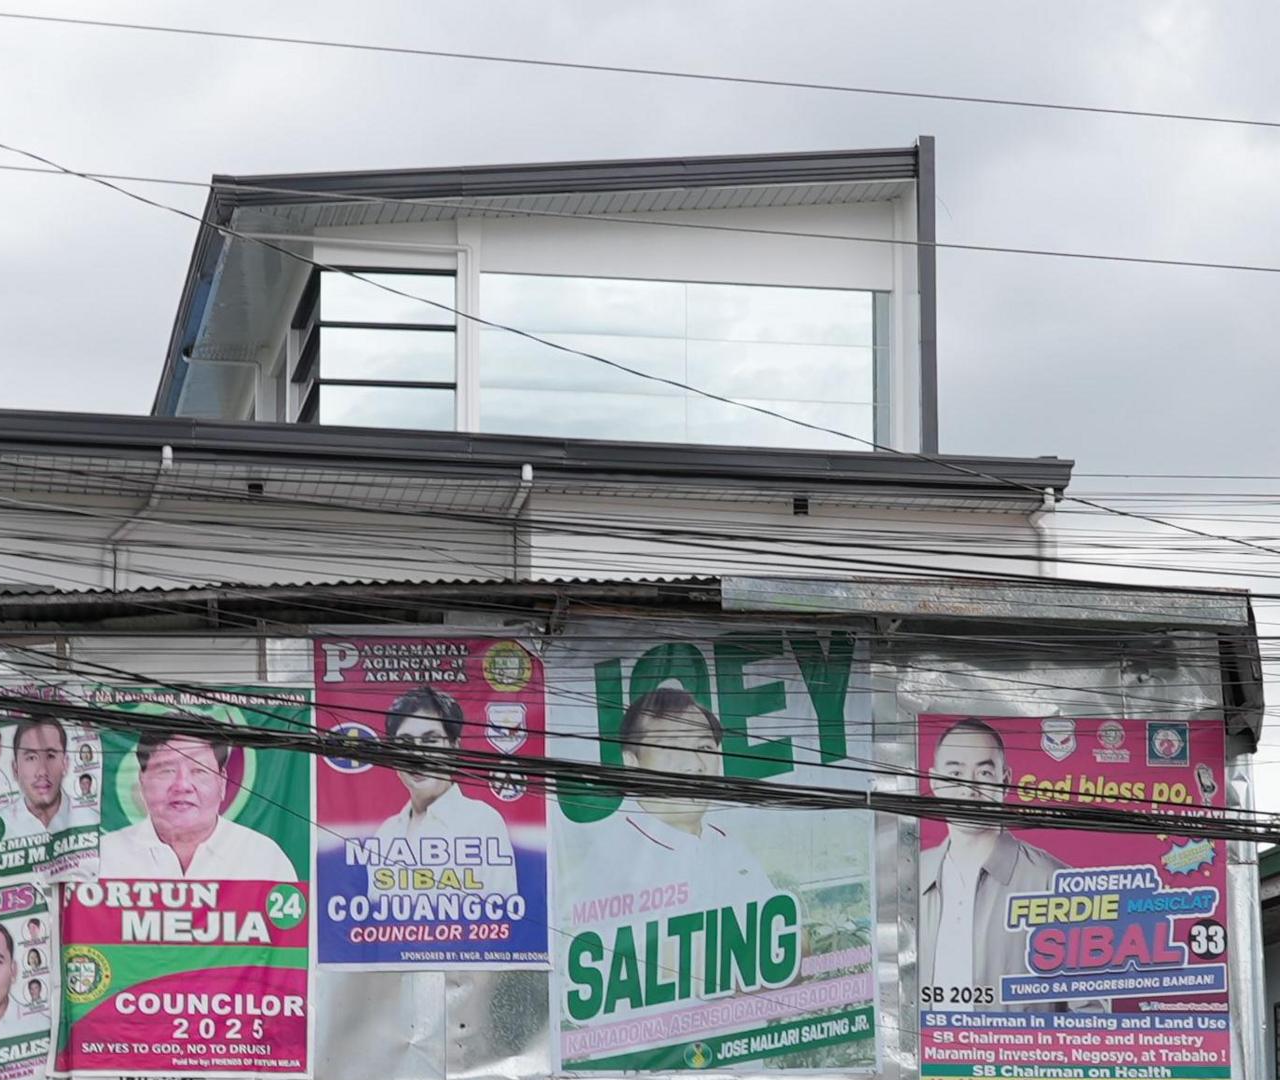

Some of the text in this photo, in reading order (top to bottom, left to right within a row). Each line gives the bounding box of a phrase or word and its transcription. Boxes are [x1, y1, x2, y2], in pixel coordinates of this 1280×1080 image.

[1018, 774, 1072, 802] God
[1078, 775, 1146, 804] bless
[28, 845, 50, 864] M.
[52, 831, 99, 857] SALES
[345, 837, 513, 867] MABEL
[373, 868, 484, 891] SIBAL
[1058, 871, 1156, 892] KONSEHAL
[269, 892, 303, 919] 24
[327, 894, 526, 922] COJUANGCO
[573, 881, 690, 925] MAYOR 2025
[1011, 894, 1212, 925] FERDIE MASICLAT
[121, 910, 271, 944] MEJIA
[349, 924, 510, 943] COUNCILOR 2025
[1190, 924, 1226, 954] 33
[567, 894, 799, 1022] SALTING
[1032, 925, 1185, 970] SIBAL
[921, 986, 995, 1003] SB 2025
[1010, 974, 1215, 995] TUNGO SA PROGRESIBONG BAMBAN!
[114, 992, 305, 1017] COUNCILOR
[925, 1014, 1227, 1031] SB Chairman in Housing and Land Use
[81, 1042, 104, 1054] SAY
[107, 1043, 130, 1054] YES
[132, 1043, 150, 1054] TO
[154, 1043, 184, 1056] GOD,
[187, 1043, 208, 1055] NO
[210, 1044, 227, 1055] TO
[717, 1014, 871, 1060] JOSE MALLARI SALTING JR.
[933, 1031, 1205, 1048] SB Chairman in Trade and Industry
[924, 1046, 996, 1063] Maraming
[999, 1047, 1069, 1063] Investors,
[1071, 1049, 1138, 1064] Negosyo,
[1141, 1049, 1156, 1062] at
[1158, 1050, 1219, 1062] Trabaho
[972, 1065, 1172, 1079] SB Chairman on Health
